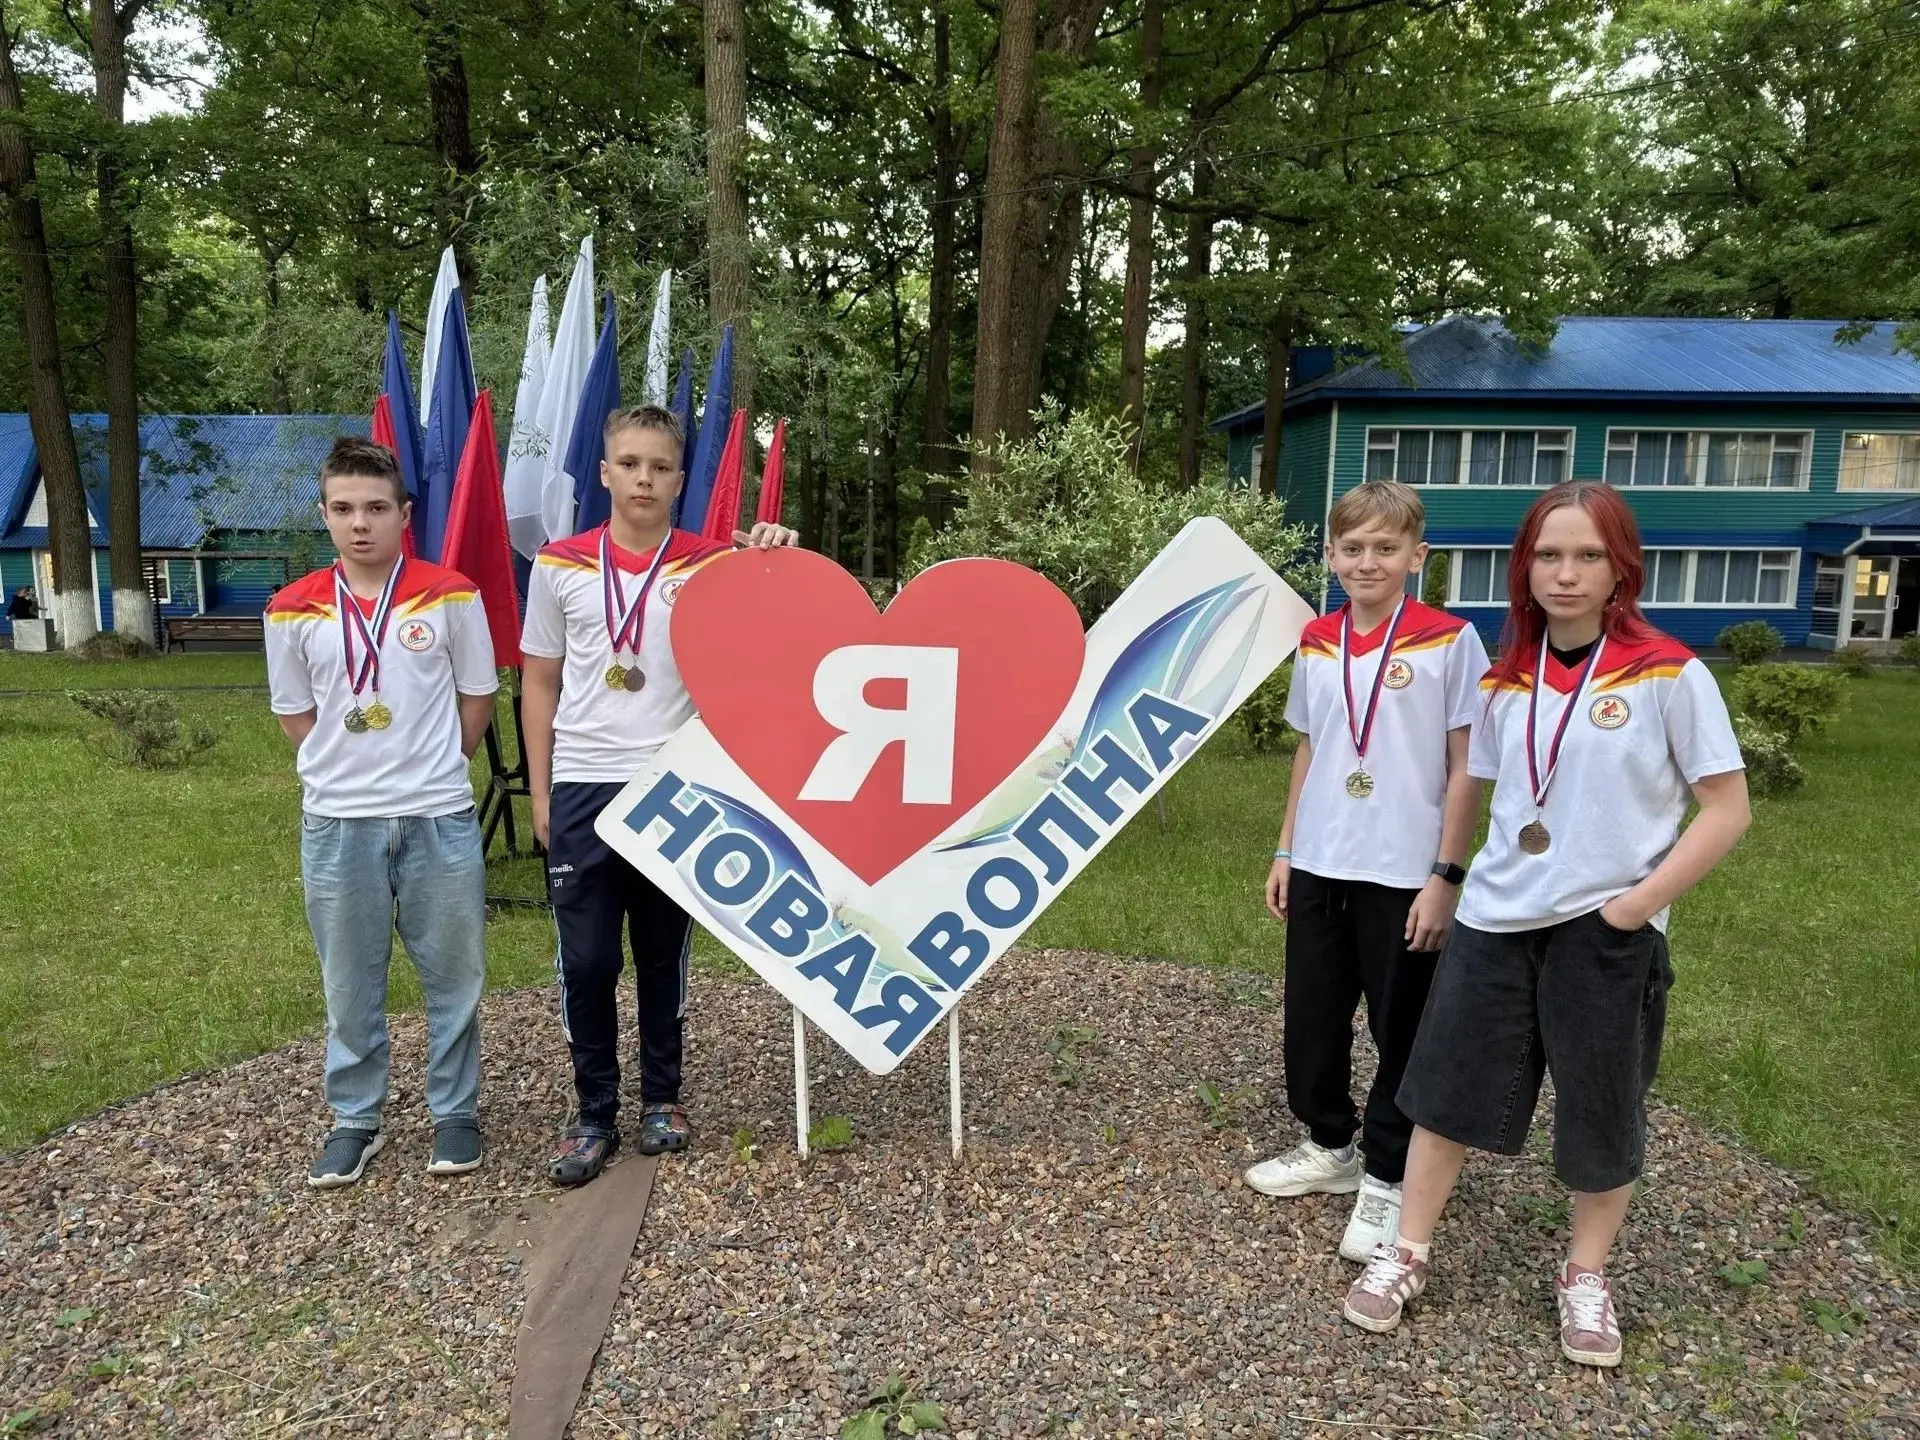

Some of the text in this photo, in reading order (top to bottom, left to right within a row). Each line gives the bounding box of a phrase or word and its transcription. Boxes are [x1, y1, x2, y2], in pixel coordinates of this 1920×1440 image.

[797, 645, 959, 805] Я
[908, 691, 1213, 990] ВОЛНА
[624, 770, 943, 1057] НОВАЯ
